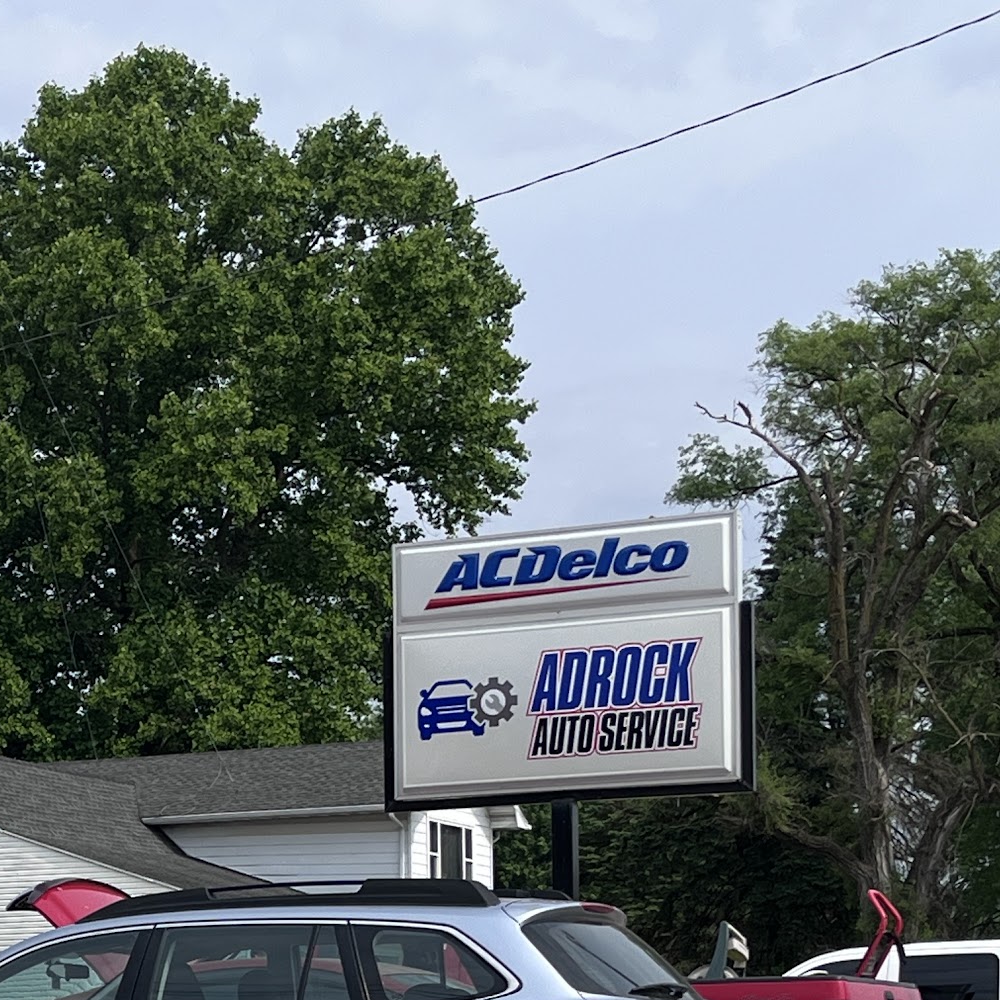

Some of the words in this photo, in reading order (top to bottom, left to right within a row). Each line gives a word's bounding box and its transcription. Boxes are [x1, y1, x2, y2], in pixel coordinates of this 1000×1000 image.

[435, 537, 690, 593] ACDelco
[530, 640, 700, 714] ADROCK
[531, 713, 597, 757] AUTO
[598, 706, 699, 753] SERVICE
